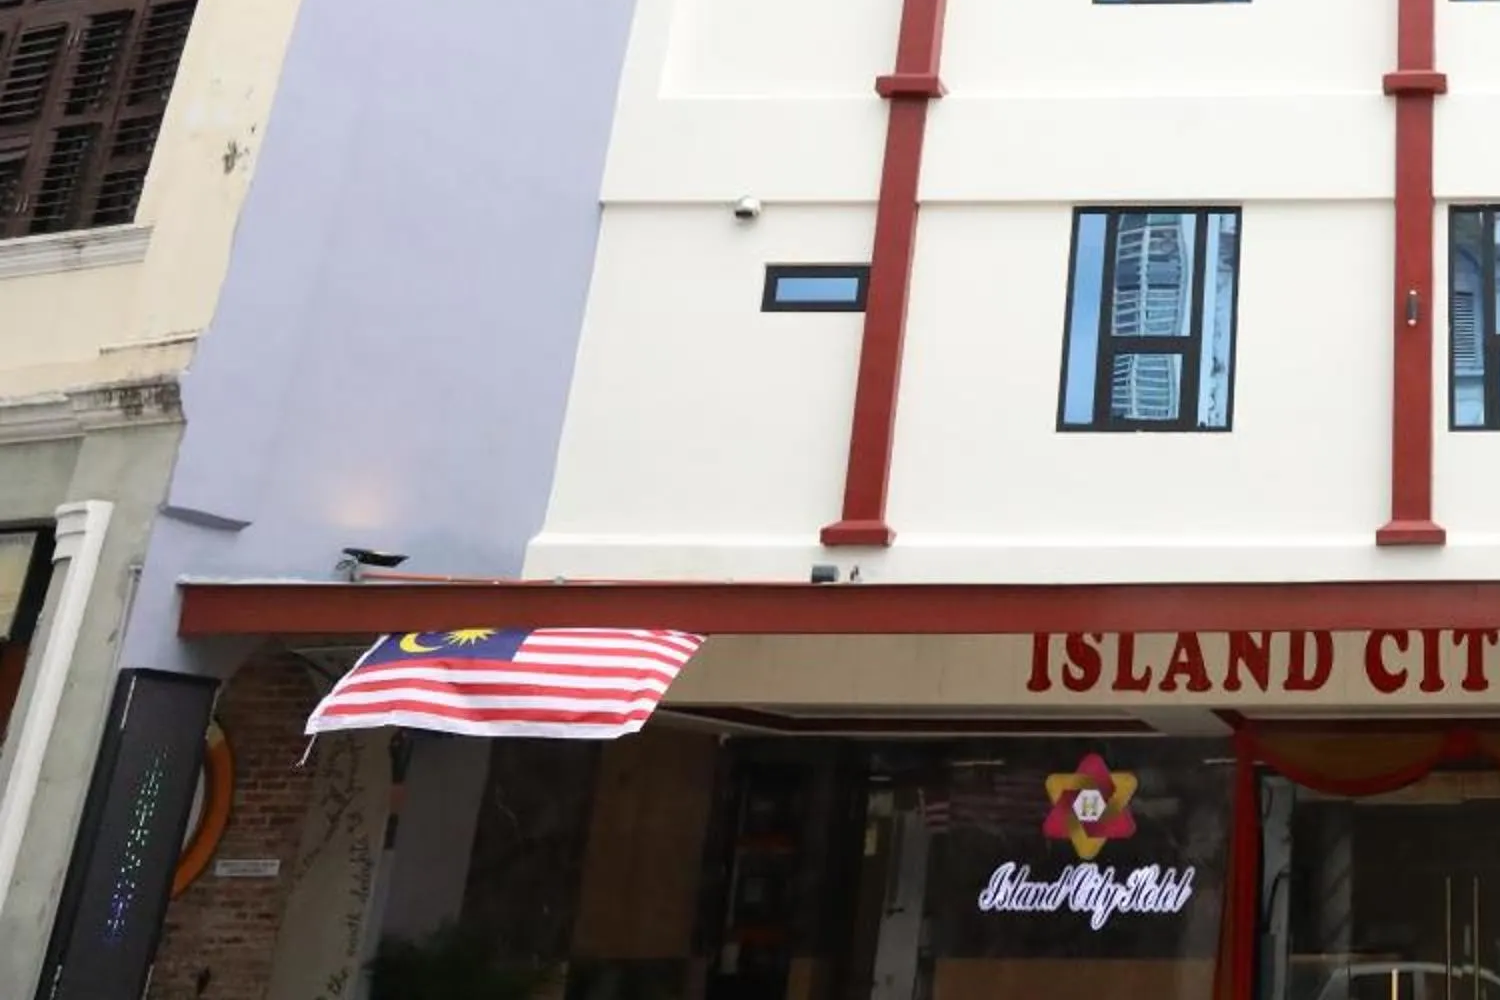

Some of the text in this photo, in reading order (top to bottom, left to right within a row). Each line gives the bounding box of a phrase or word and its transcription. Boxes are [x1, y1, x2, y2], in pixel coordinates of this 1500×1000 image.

[1027, 629, 1333, 692] ISLAND
[979, 861, 1196, 931] Island City Hotel
